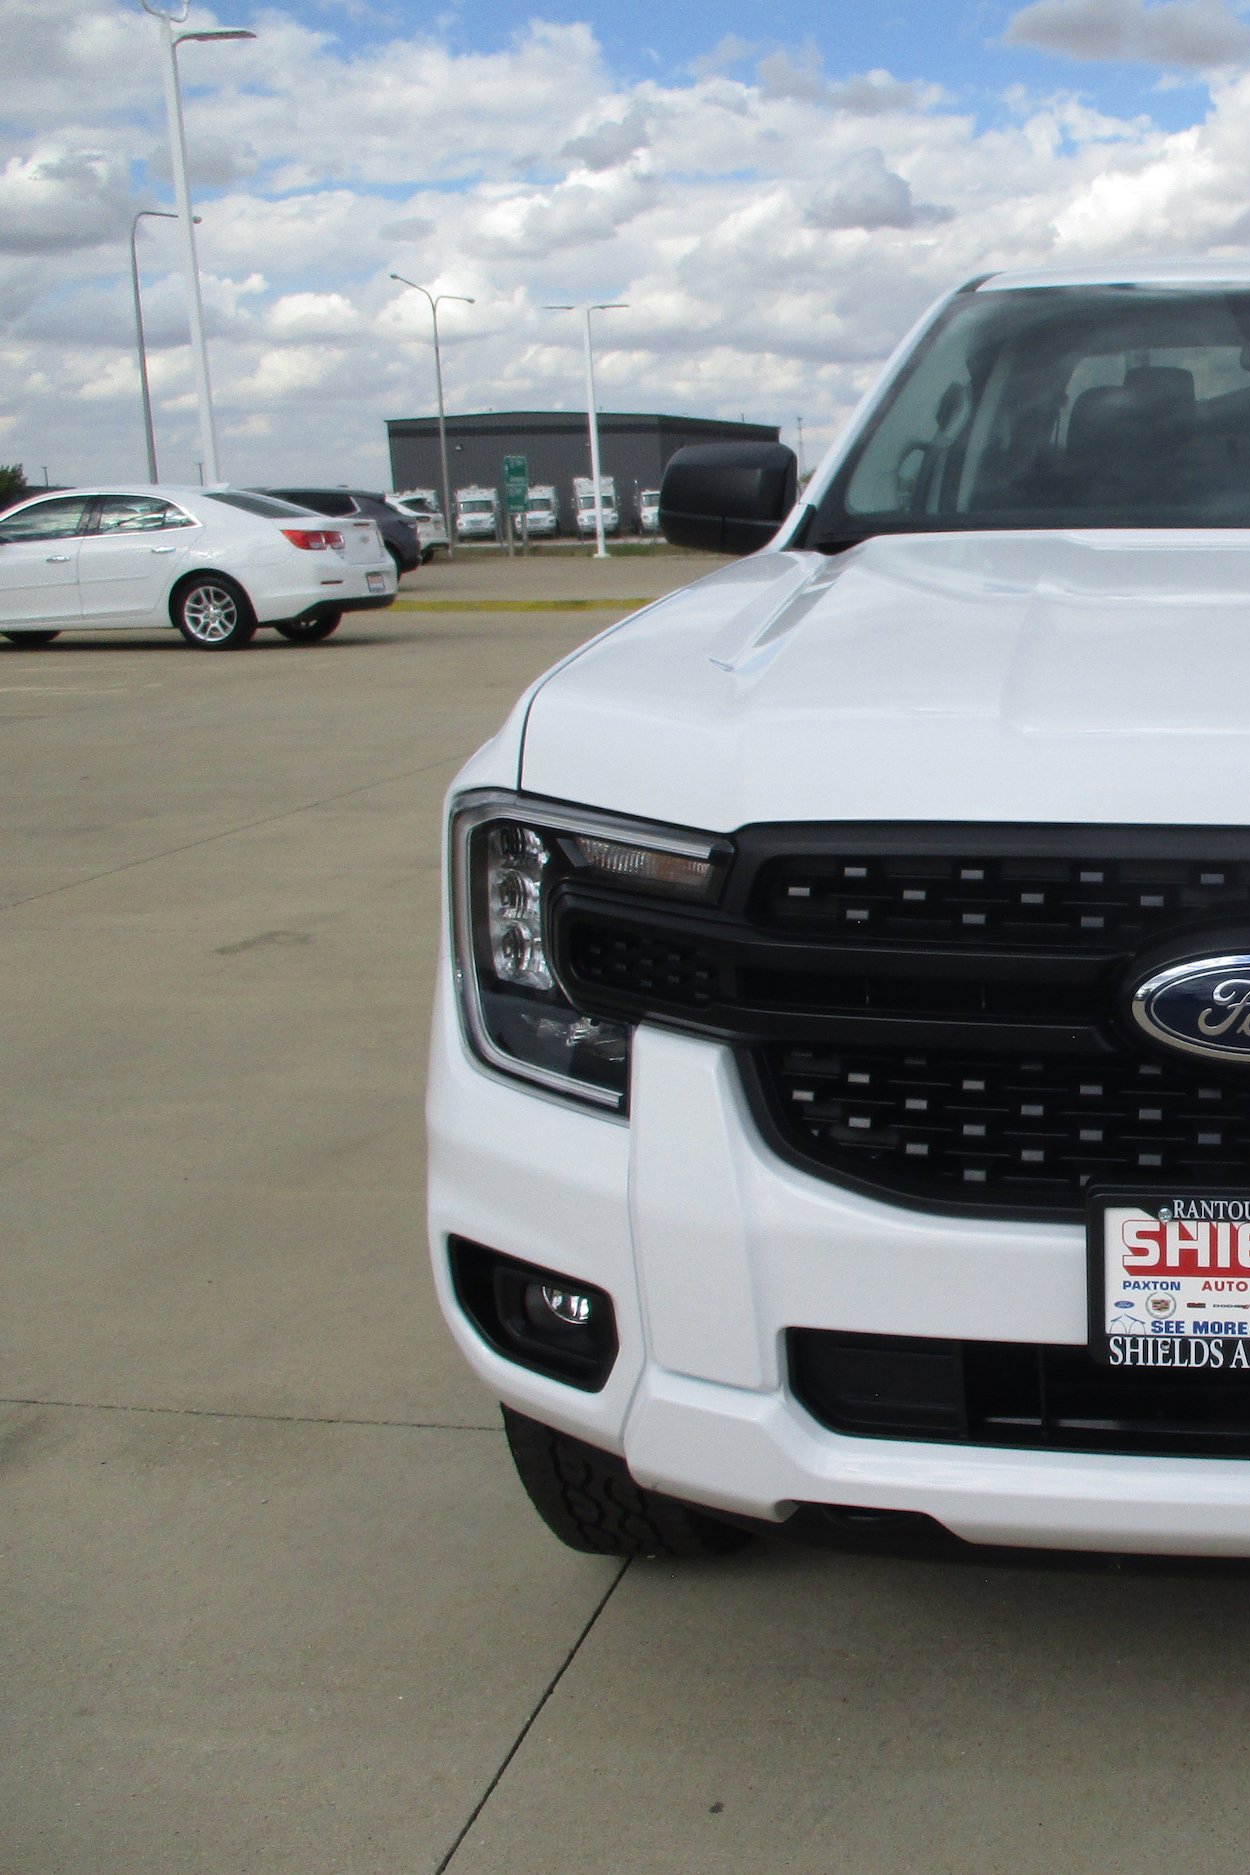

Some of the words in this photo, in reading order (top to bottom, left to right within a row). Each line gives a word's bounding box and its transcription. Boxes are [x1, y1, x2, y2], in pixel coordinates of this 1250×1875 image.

[1123, 1280, 1181, 1291] PAXTON
[1202, 1281, 1248, 1293] AUTO
[1151, 1320, 1185, 1335] SEE
[1192, 1321, 1248, 1336] MORE
[1109, 1336, 1225, 1367] SHIELDS
